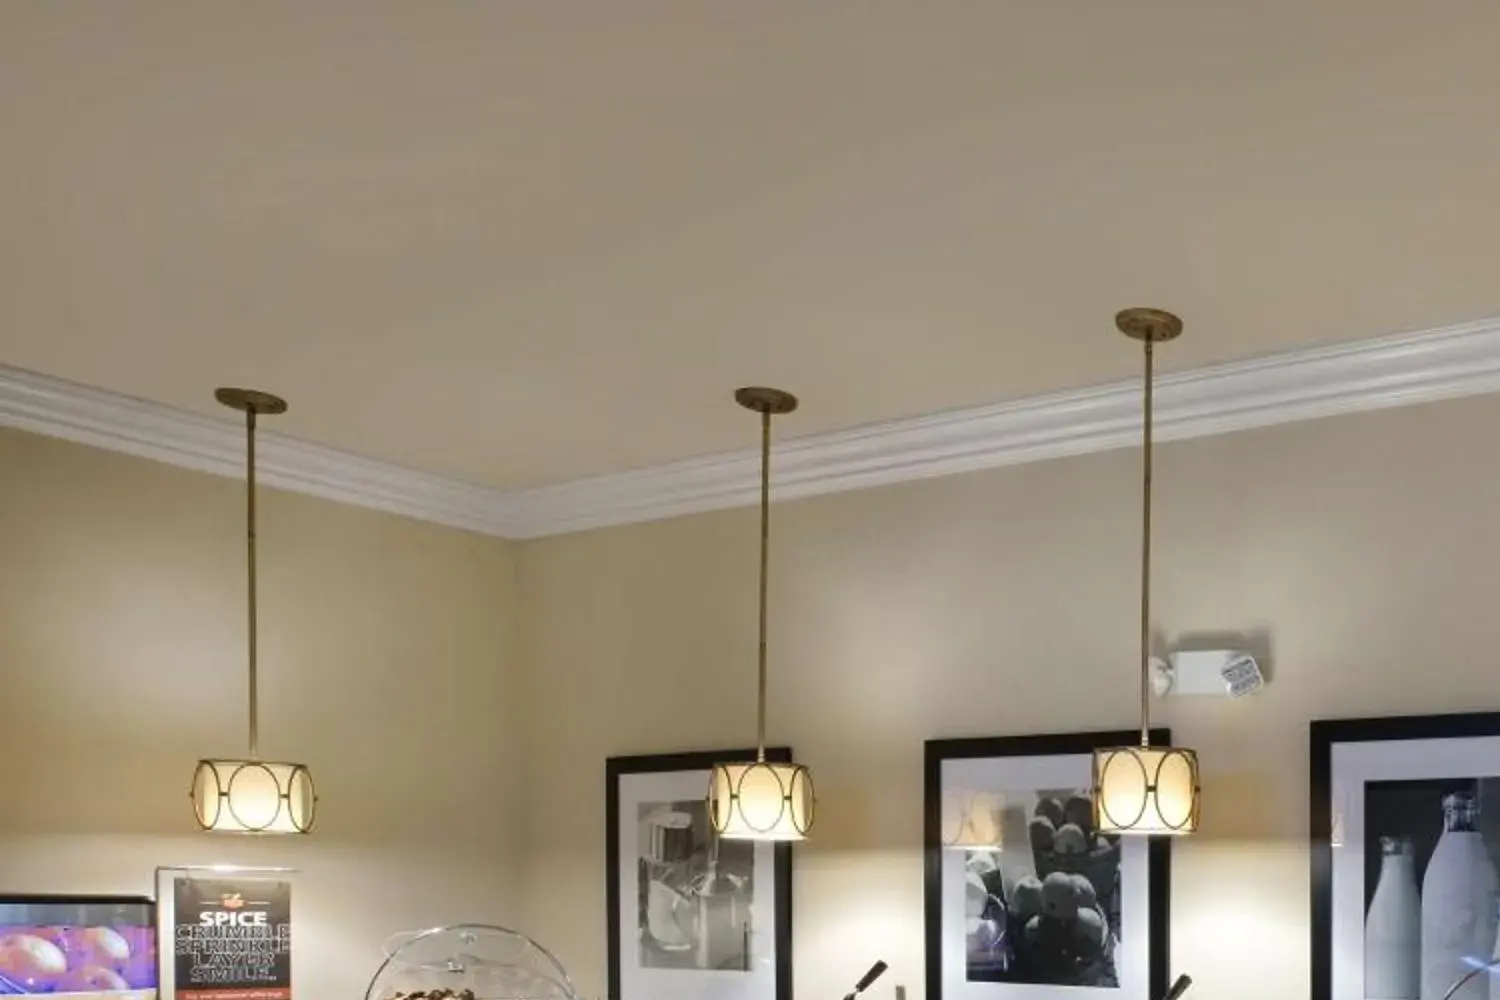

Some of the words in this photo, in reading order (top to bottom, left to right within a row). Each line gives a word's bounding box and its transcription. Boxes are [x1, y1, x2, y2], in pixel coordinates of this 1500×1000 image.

[199, 911, 268, 927] SPICE
[175, 938, 290, 955] SPRINKLE
[193, 952, 275, 968] LAYER
